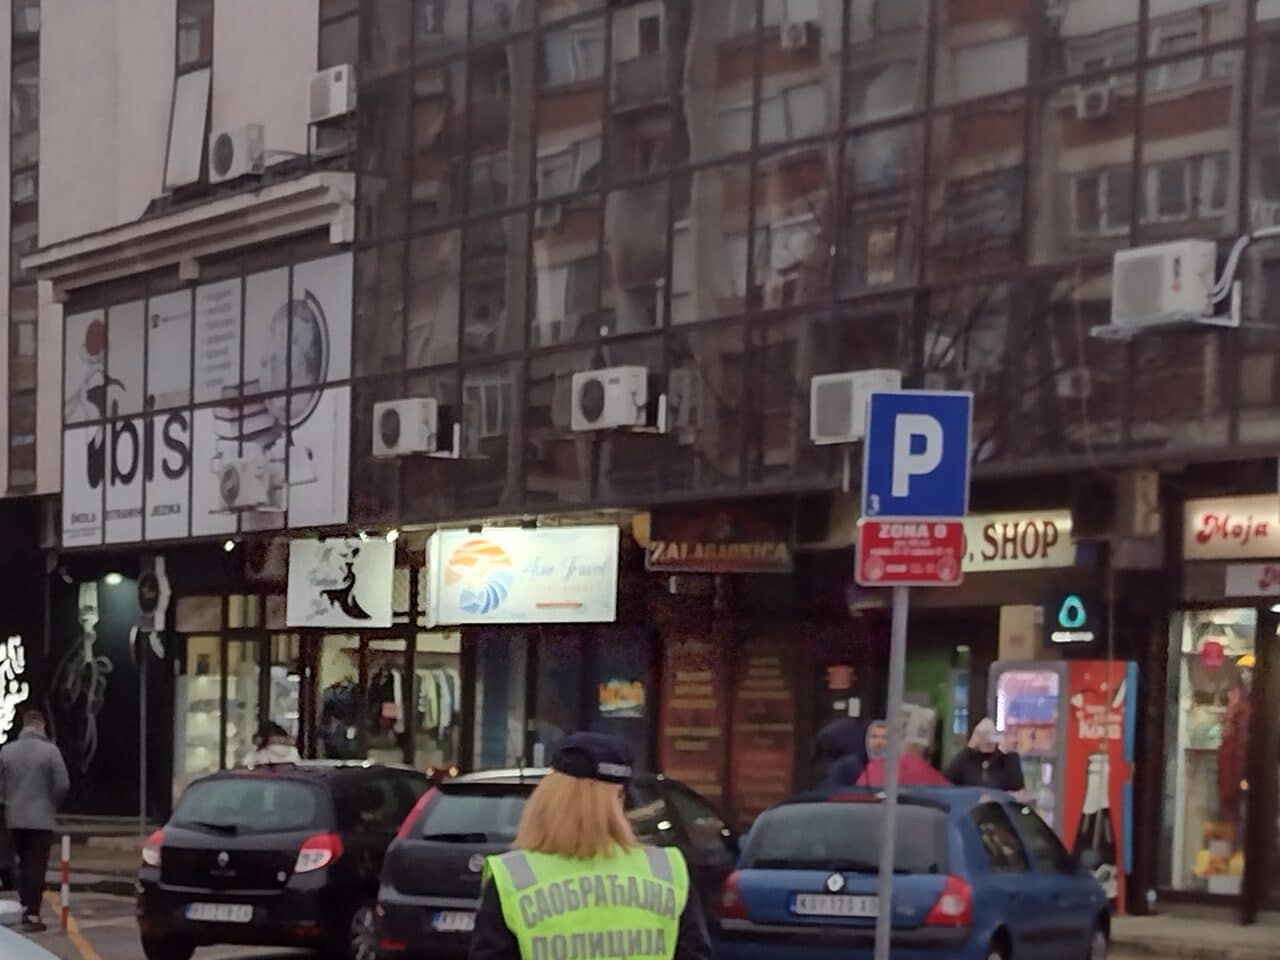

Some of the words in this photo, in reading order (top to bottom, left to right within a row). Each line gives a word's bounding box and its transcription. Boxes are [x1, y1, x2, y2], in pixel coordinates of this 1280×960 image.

[891, 413, 944, 497] P
[878, 524, 929, 539] ZONA
[981, 520, 1059, 561] SHOP
[1195, 512, 1268, 546] Moja
[520, 874, 676, 929] САОБРАЋАЈНА
